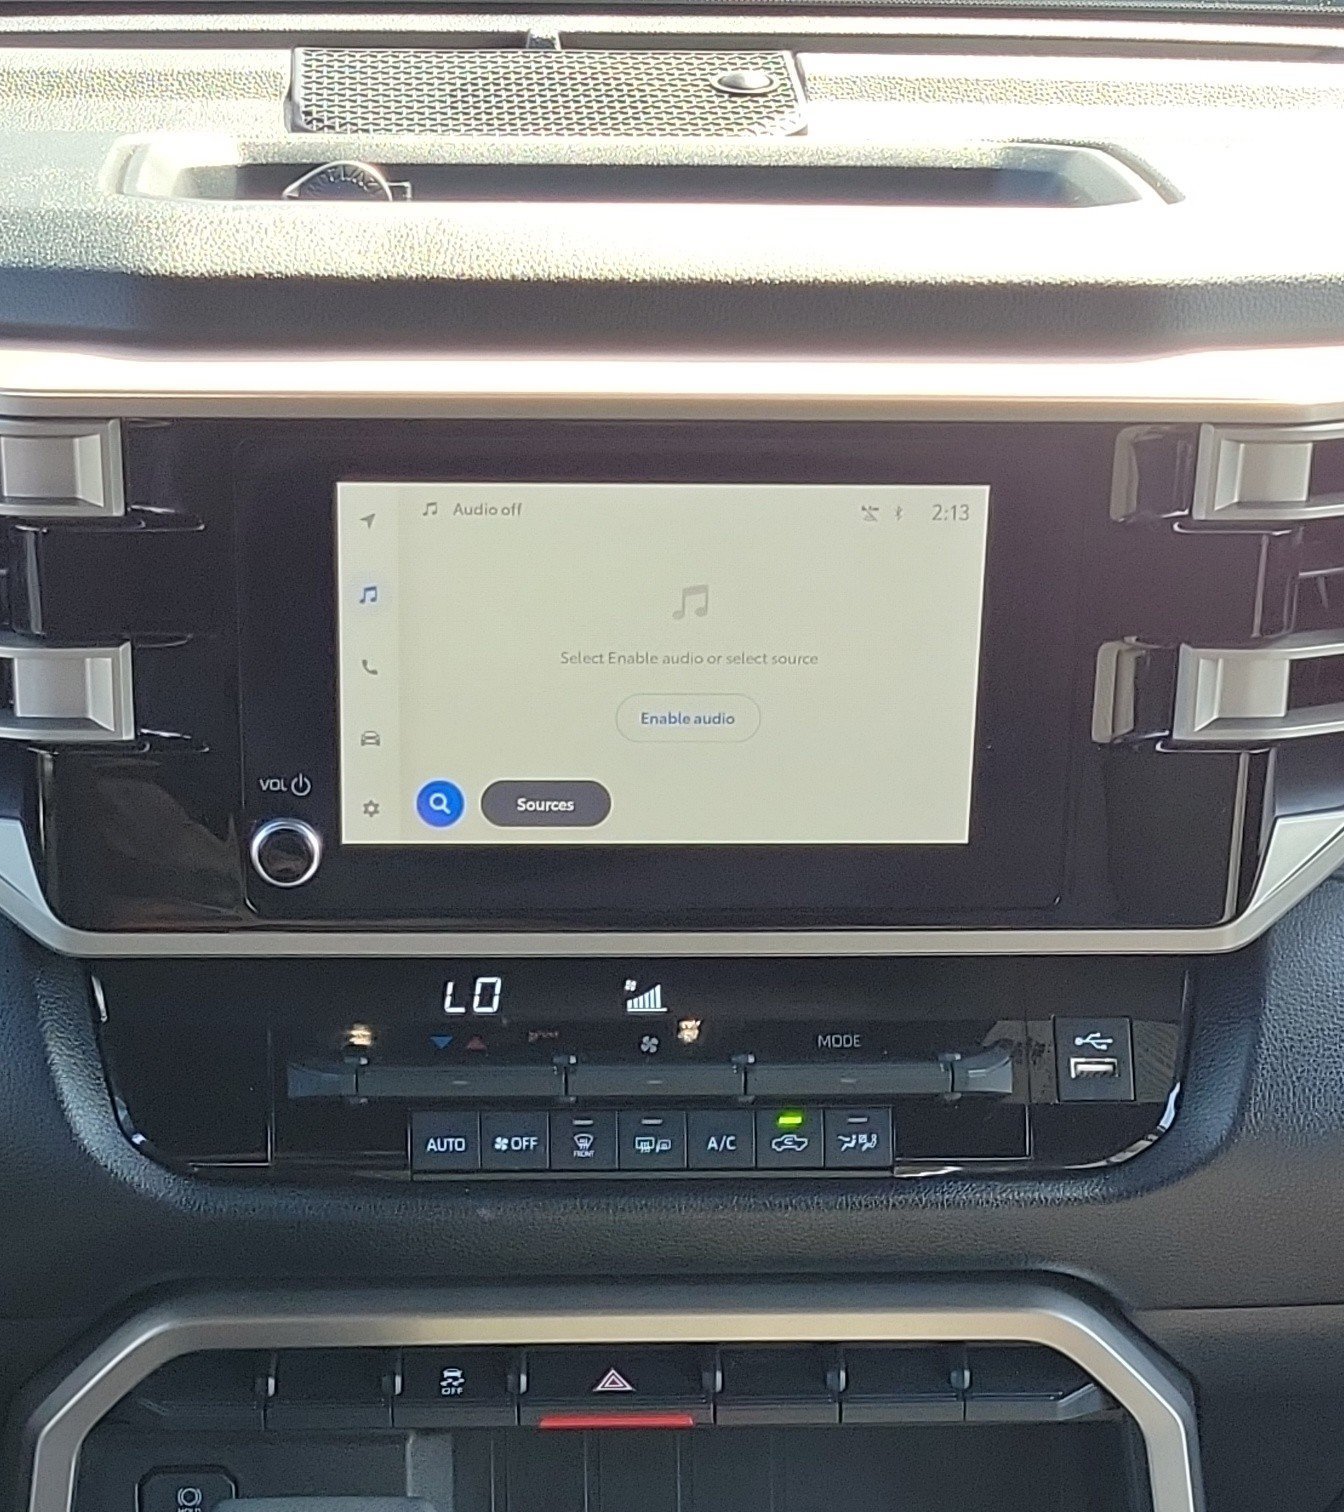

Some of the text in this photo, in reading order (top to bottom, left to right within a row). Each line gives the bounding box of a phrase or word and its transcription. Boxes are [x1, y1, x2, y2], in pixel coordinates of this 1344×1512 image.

[452, 501, 523, 516] Audio off
[932, 504, 970, 521] 2:13
[559, 652, 818, 665] Select Enable audio or select source
[641, 711, 735, 725] Enable audio
[259, 777, 288, 791] VOL
[517, 798, 575, 811] Sources
[444, 976, 502, 1013] LO
[818, 1034, 862, 1049] MODE
[426, 1137, 466, 1152] AUTO
[511, 1137, 538, 1151] OFF
[707, 1136, 736, 1151] A/C
